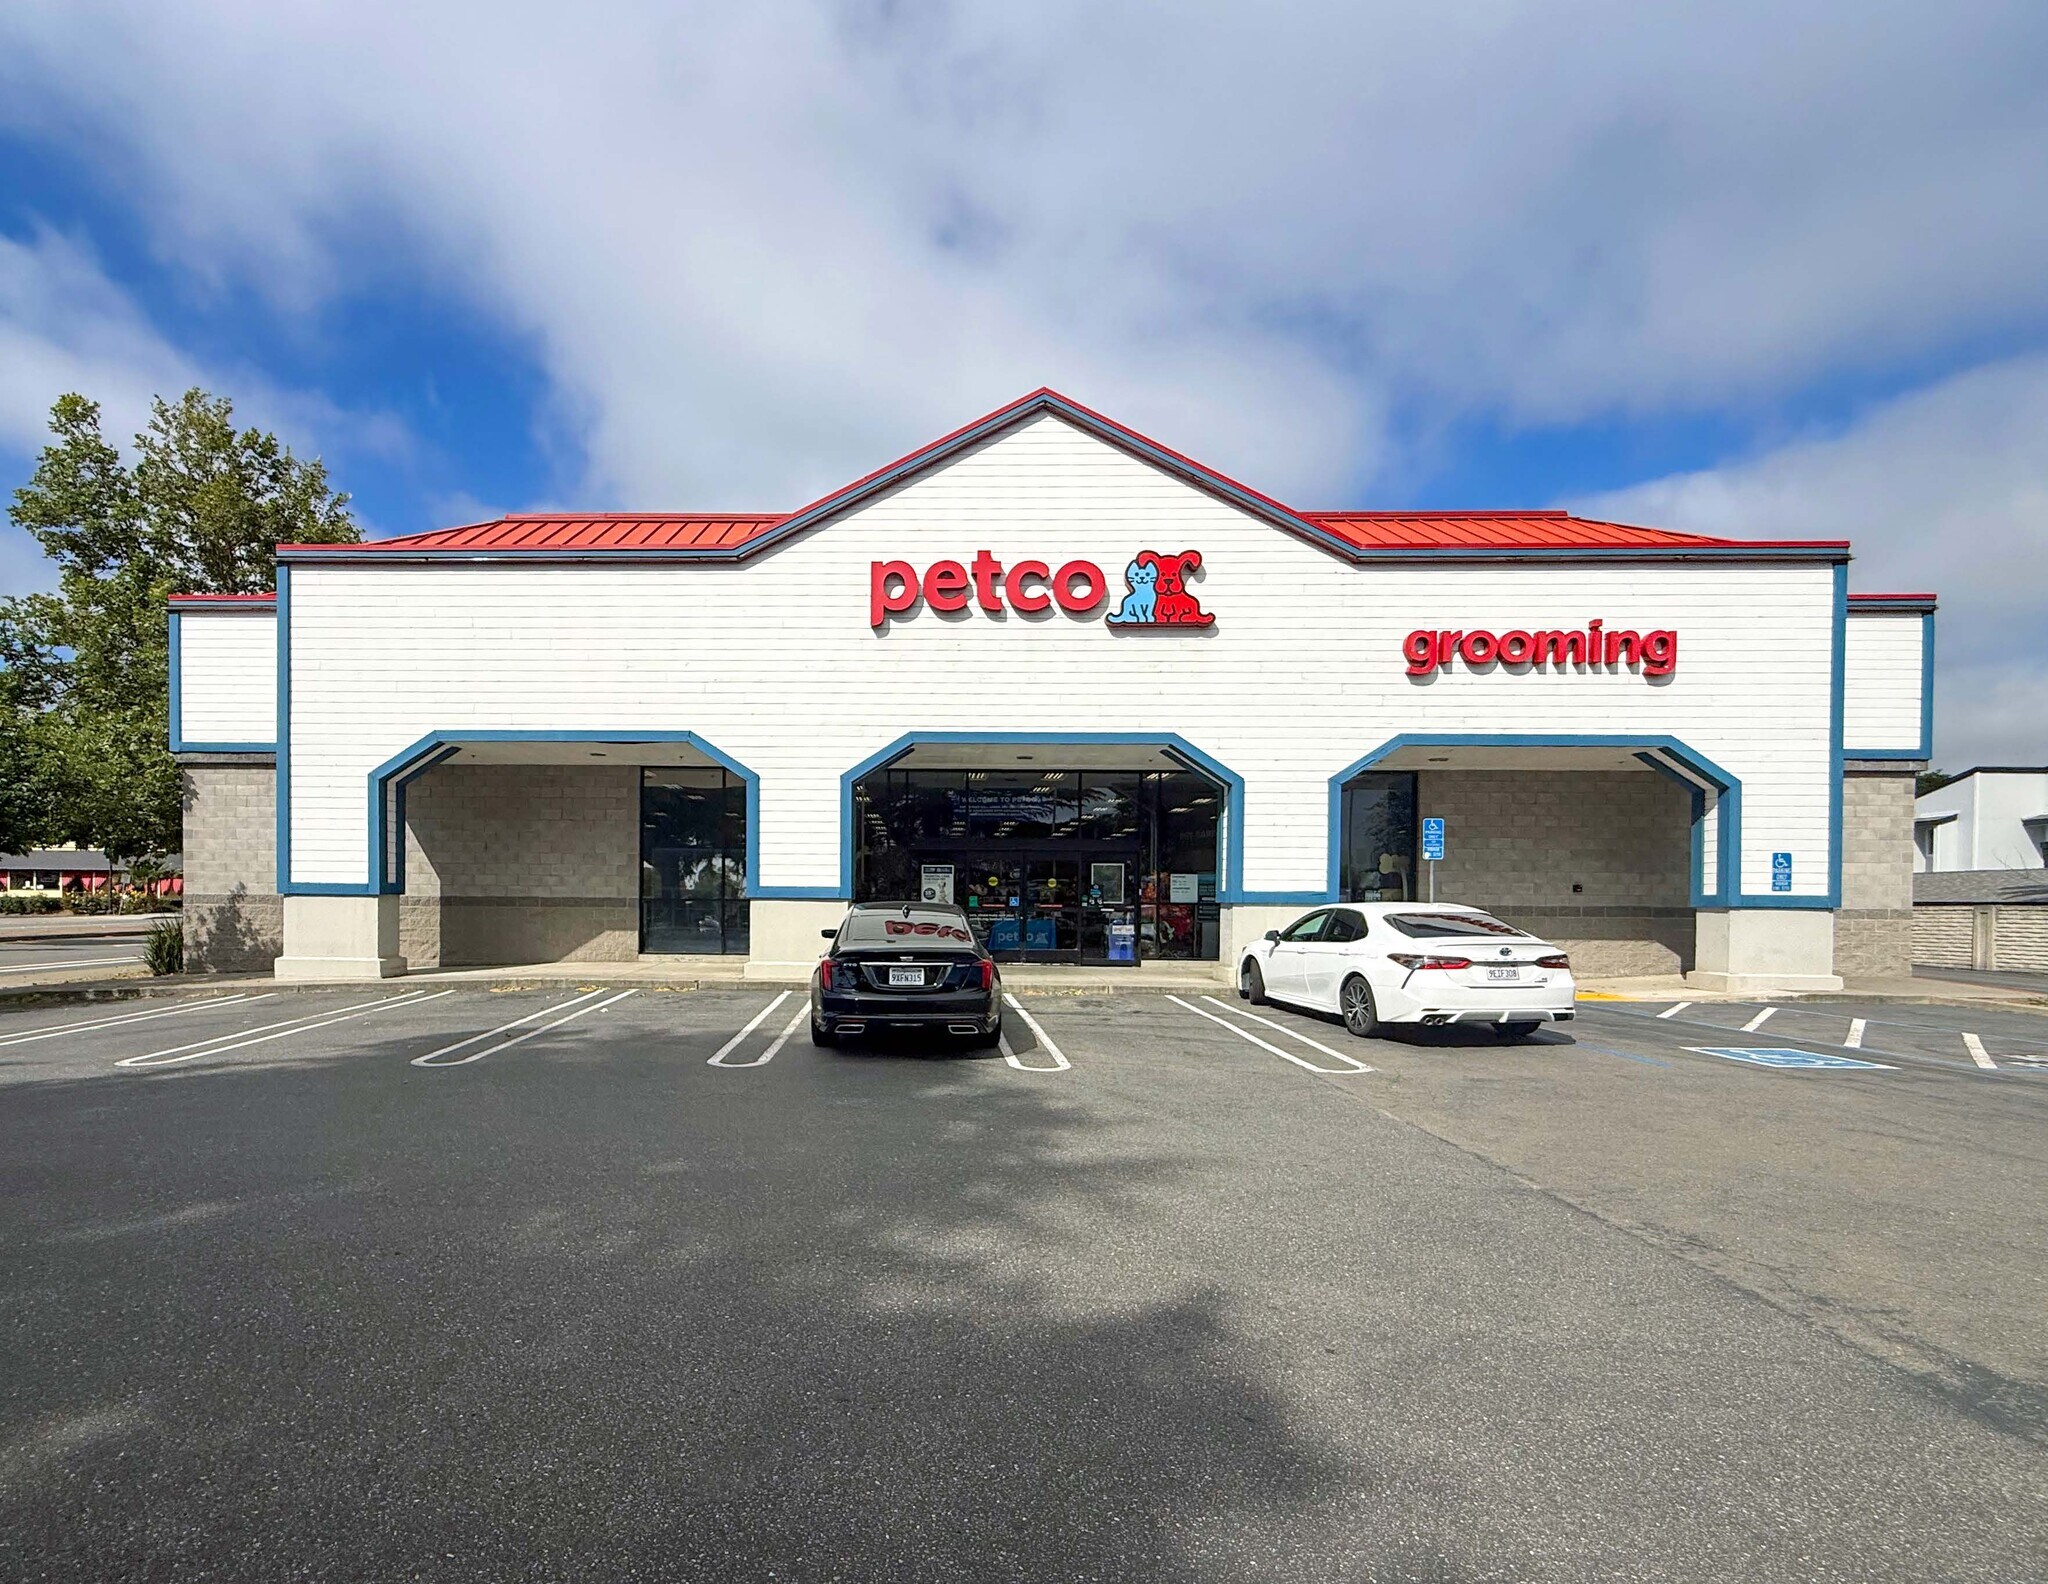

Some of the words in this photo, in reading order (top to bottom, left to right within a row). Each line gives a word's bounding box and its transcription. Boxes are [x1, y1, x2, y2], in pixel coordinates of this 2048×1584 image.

[870, 549, 1106, 628] petco
[1402, 618, 1678, 675] grooming
[997, 932, 1034, 944] peto
